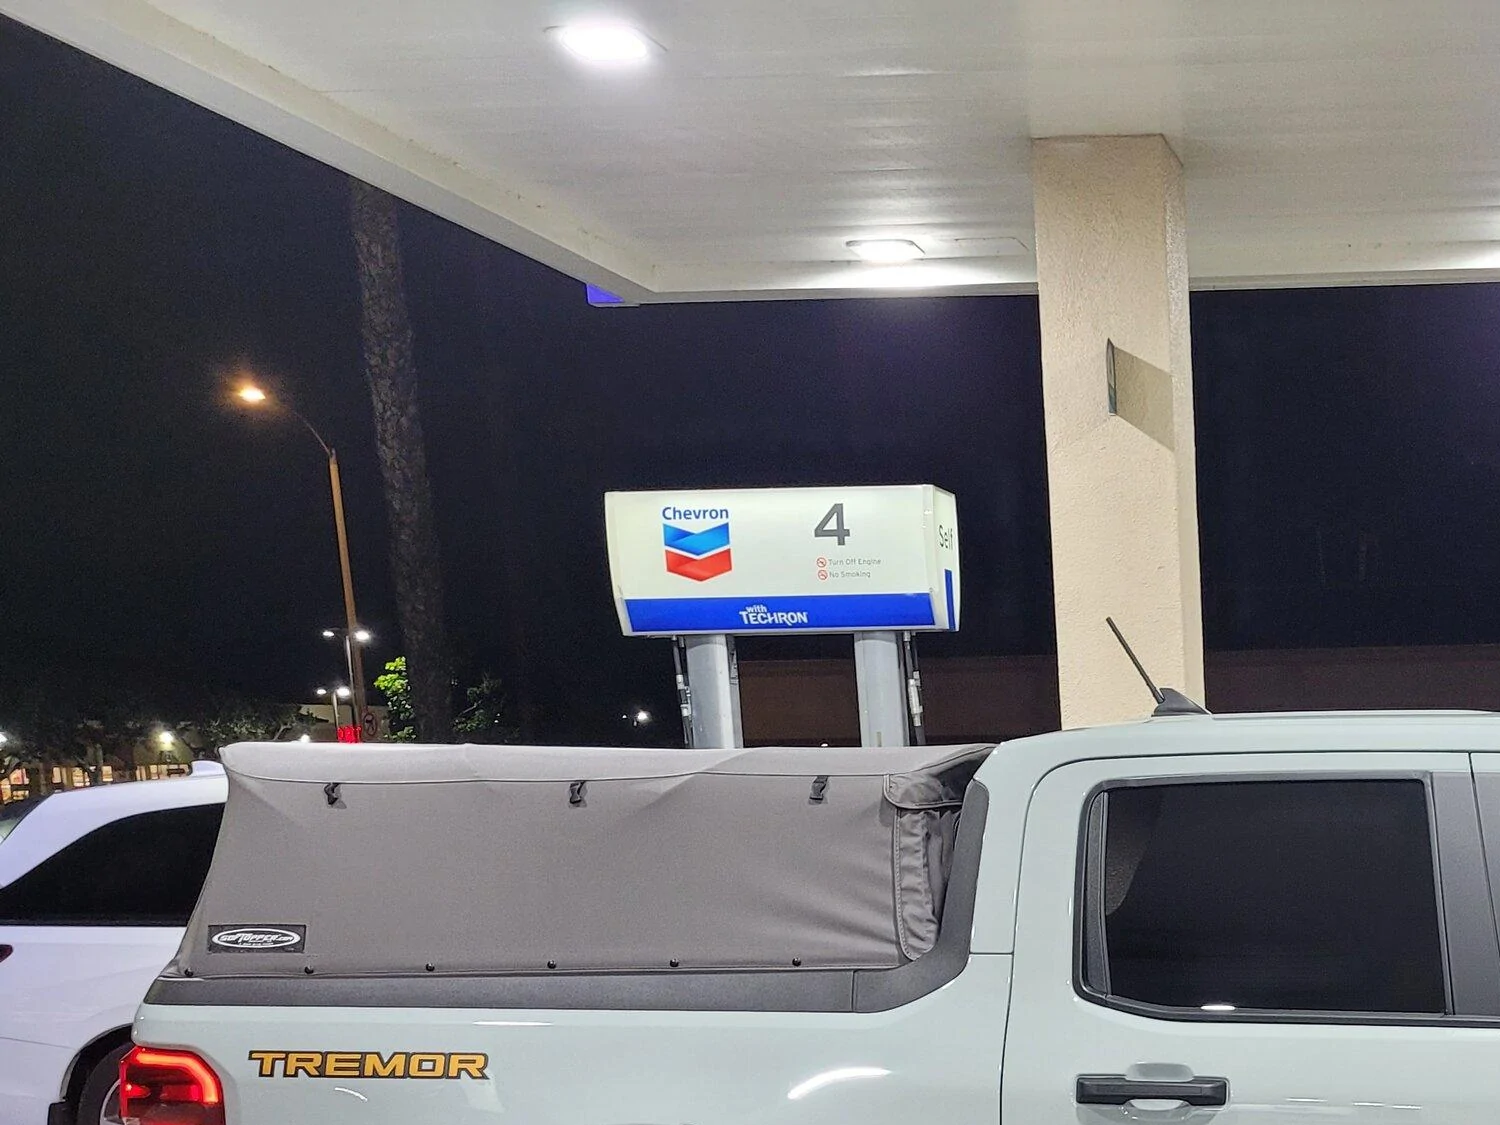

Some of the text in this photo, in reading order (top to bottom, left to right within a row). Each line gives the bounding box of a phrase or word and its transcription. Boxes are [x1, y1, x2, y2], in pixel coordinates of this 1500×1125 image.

[661, 506, 729, 520] Chevron
[814, 503, 850, 546] 4
[858, 558, 882, 566] Engine
[841, 571, 871, 579] Smoking
[745, 605, 767, 613] with
[739, 611, 808, 626] TECHRON
[249, 1050, 489, 1080] TREMOR
